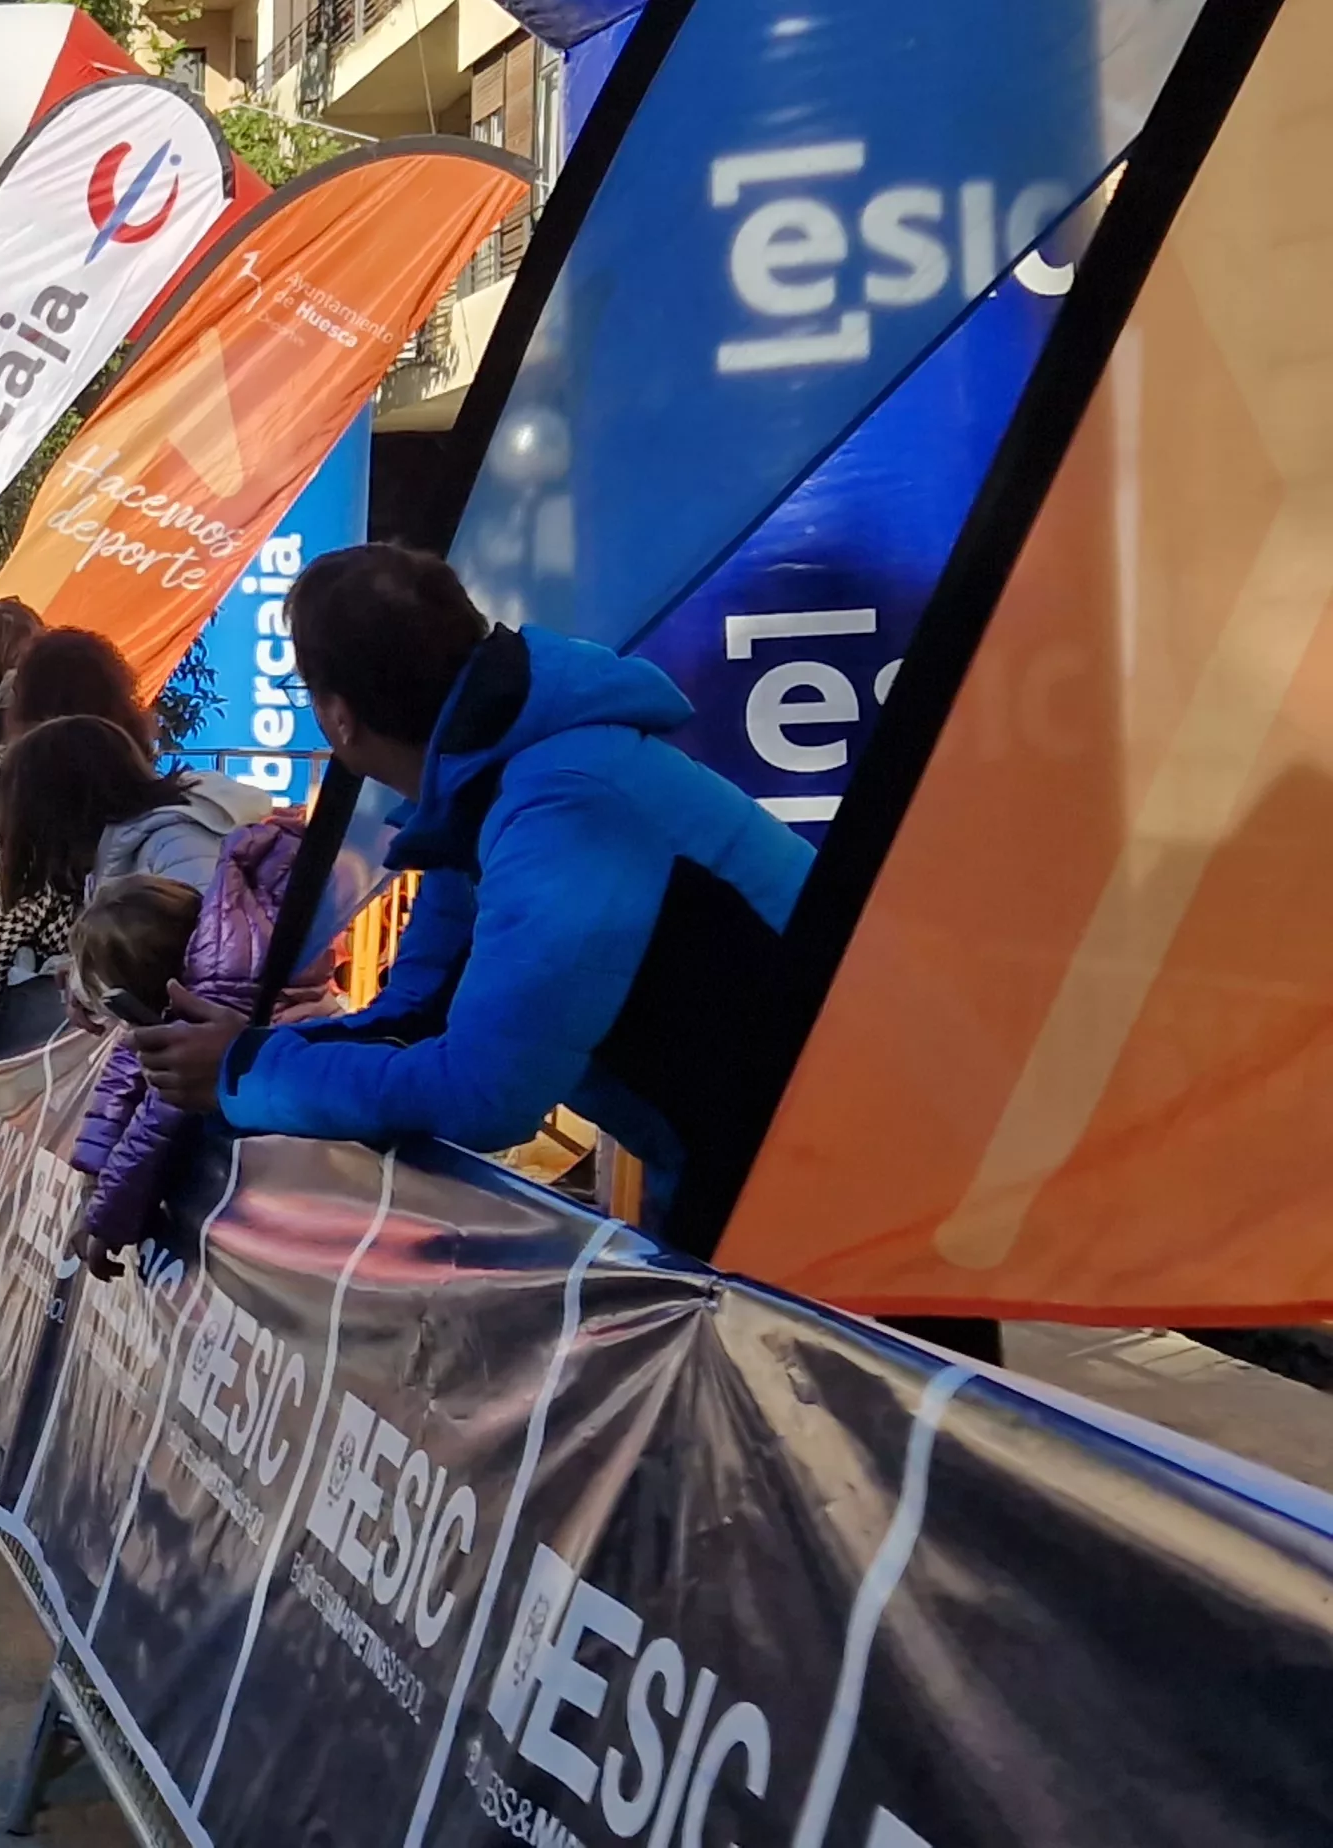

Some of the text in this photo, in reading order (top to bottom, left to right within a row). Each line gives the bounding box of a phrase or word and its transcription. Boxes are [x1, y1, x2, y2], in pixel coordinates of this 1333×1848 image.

[274, 289, 360, 348] de Huesca
[285, 271, 394, 344] Ayuntamiento
[47, 494, 207, 590] deporte
[61, 443, 245, 558] Hacemos
[200, 1304, 306, 1487] ESIC
[337, 1417, 477, 1648] ESIC
